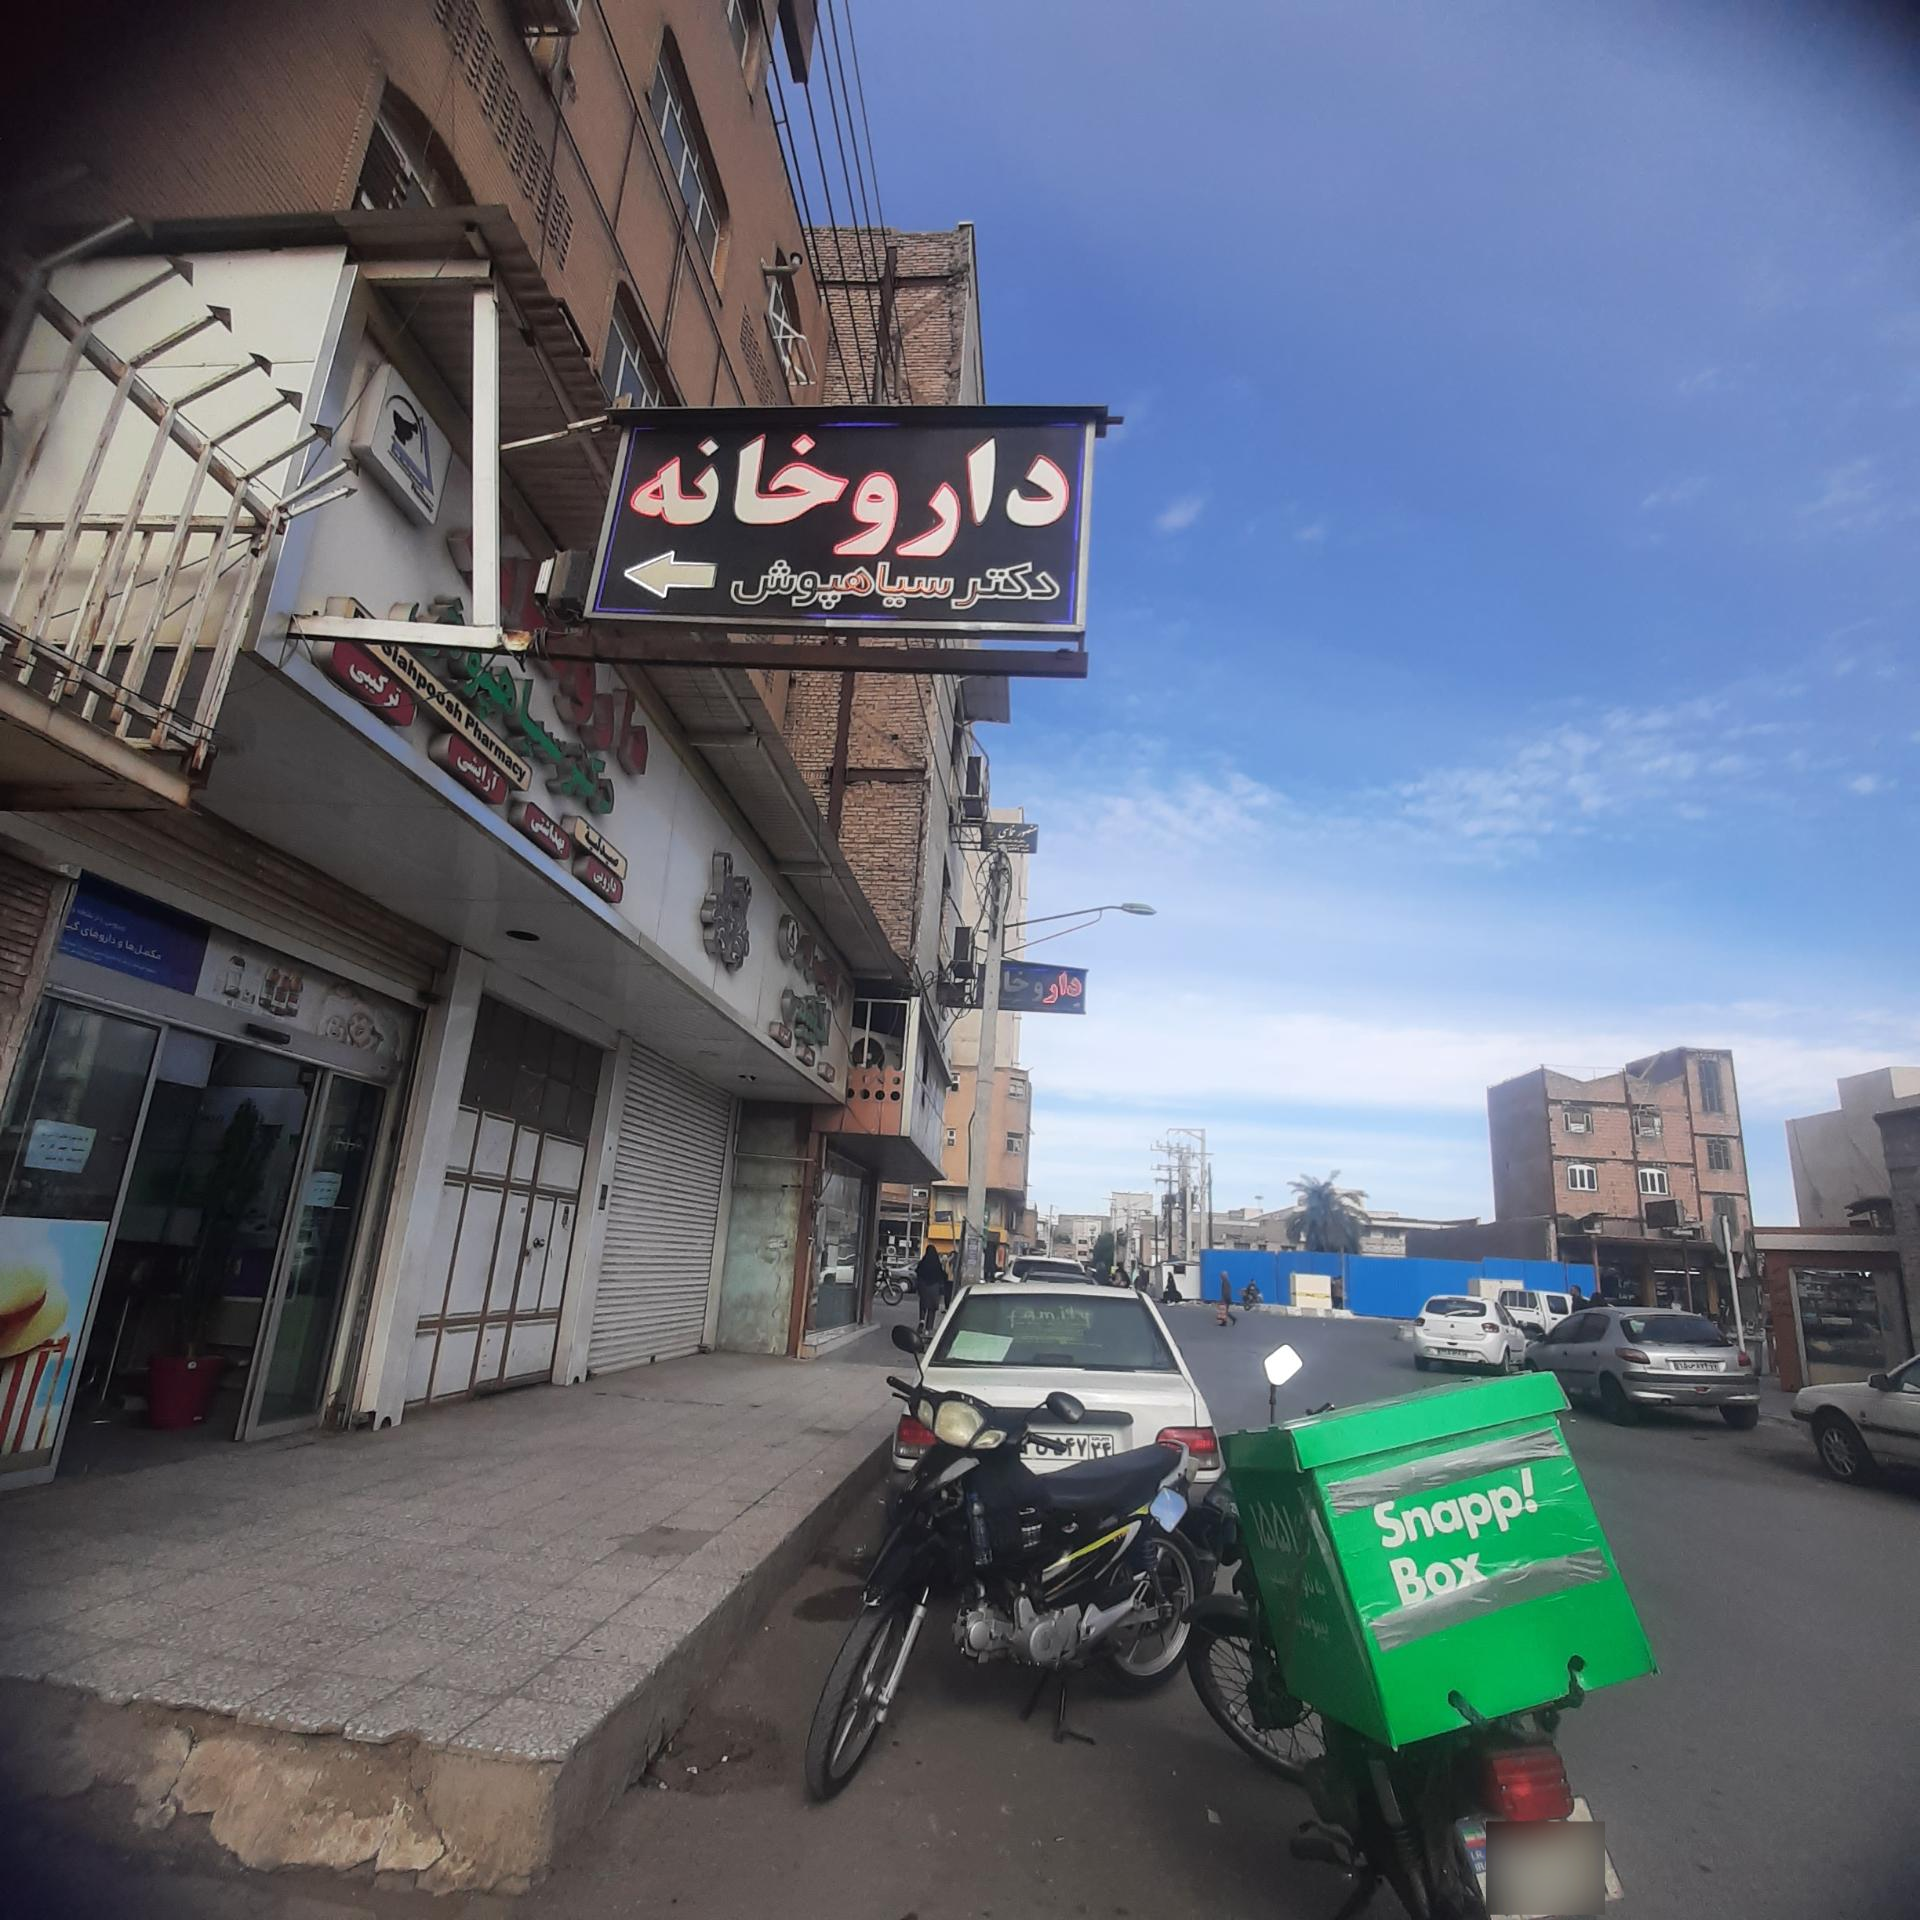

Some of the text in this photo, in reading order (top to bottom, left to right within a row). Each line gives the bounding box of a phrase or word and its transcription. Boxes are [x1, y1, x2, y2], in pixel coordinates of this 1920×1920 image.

[630, 433, 1070, 558] داروخانه
[729, 559, 1060, 611] دکتر سیاهپوش
[463, 712, 528, 784] Pharmacy
[1373, 1467, 1539, 1549] Snapp!
[1388, 1552, 1489, 1608] Box
